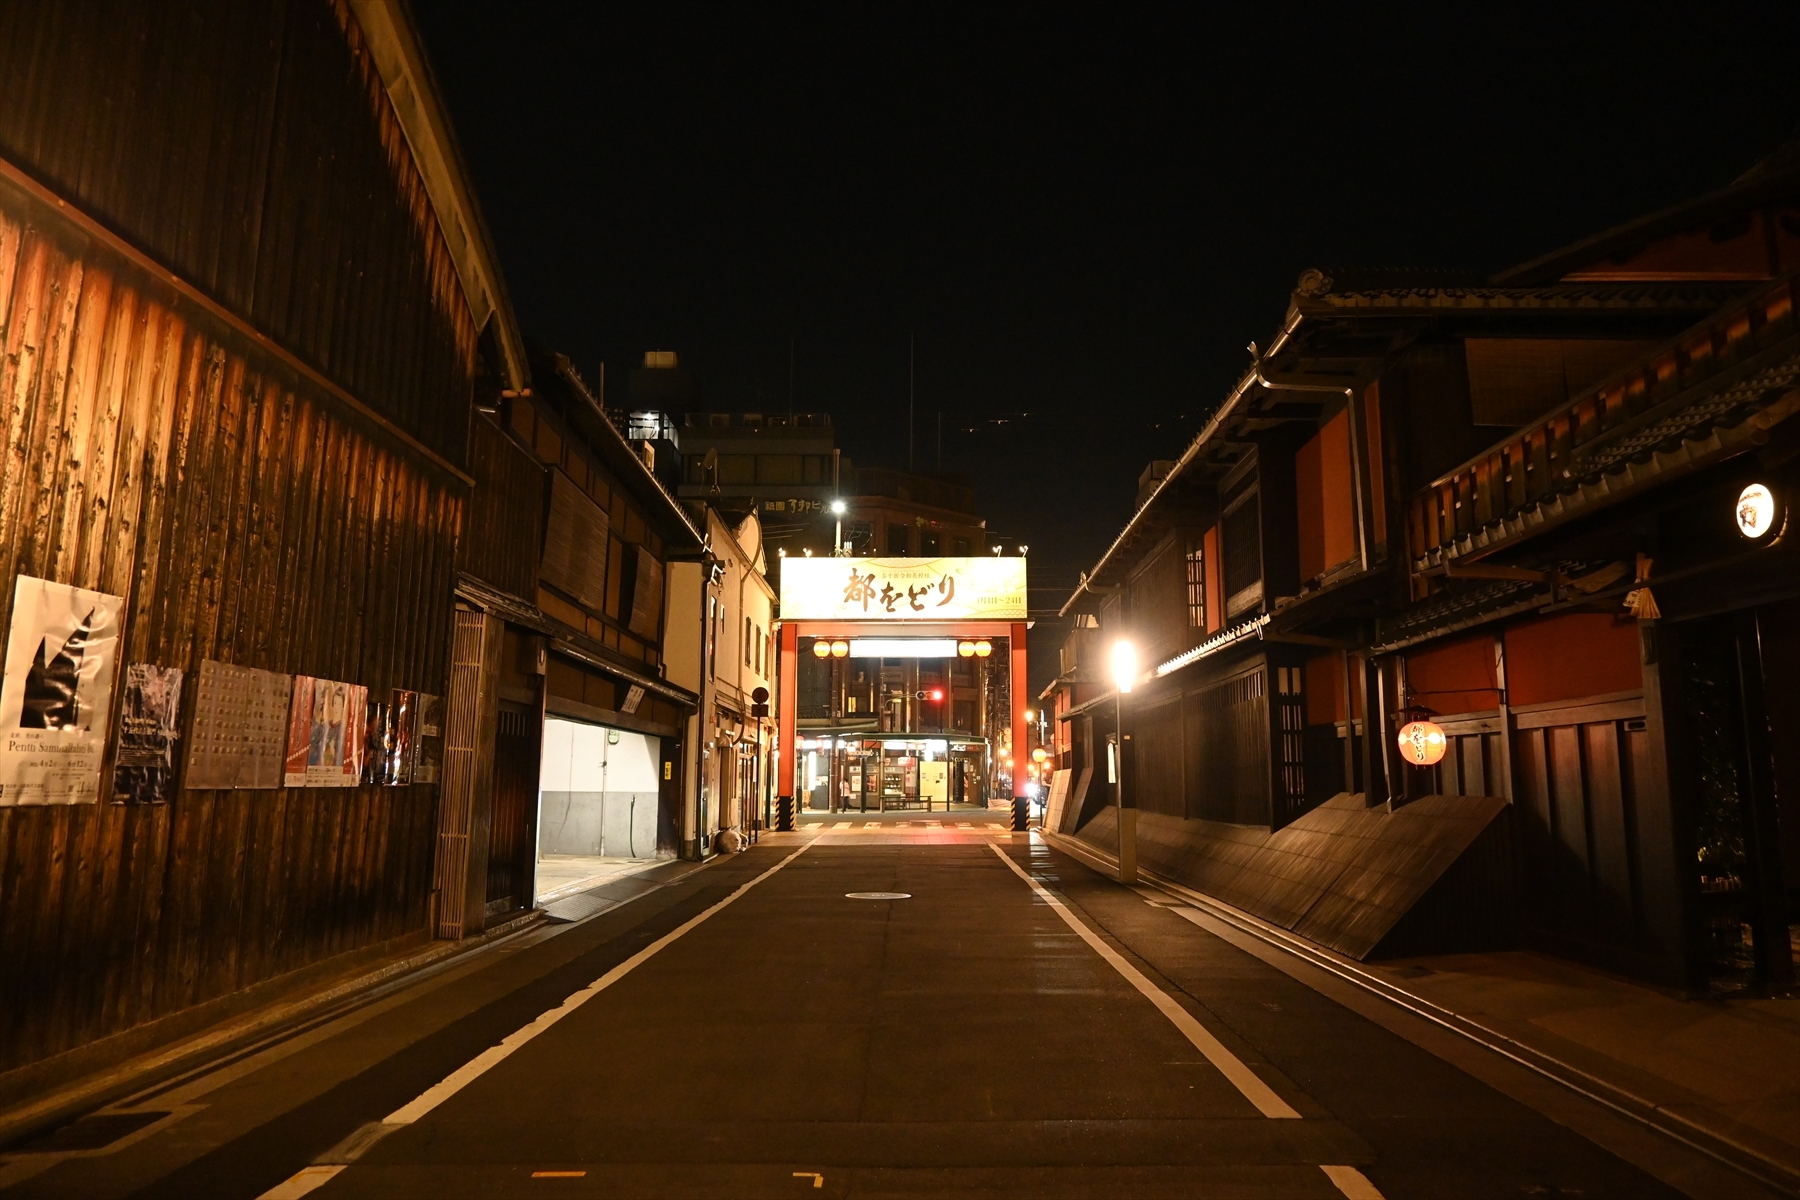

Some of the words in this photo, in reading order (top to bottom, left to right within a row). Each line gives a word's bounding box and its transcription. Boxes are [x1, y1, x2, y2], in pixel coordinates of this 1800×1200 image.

[843, 567, 955, 613] 都をどり
[8, 740, 36, 752] Pentti
